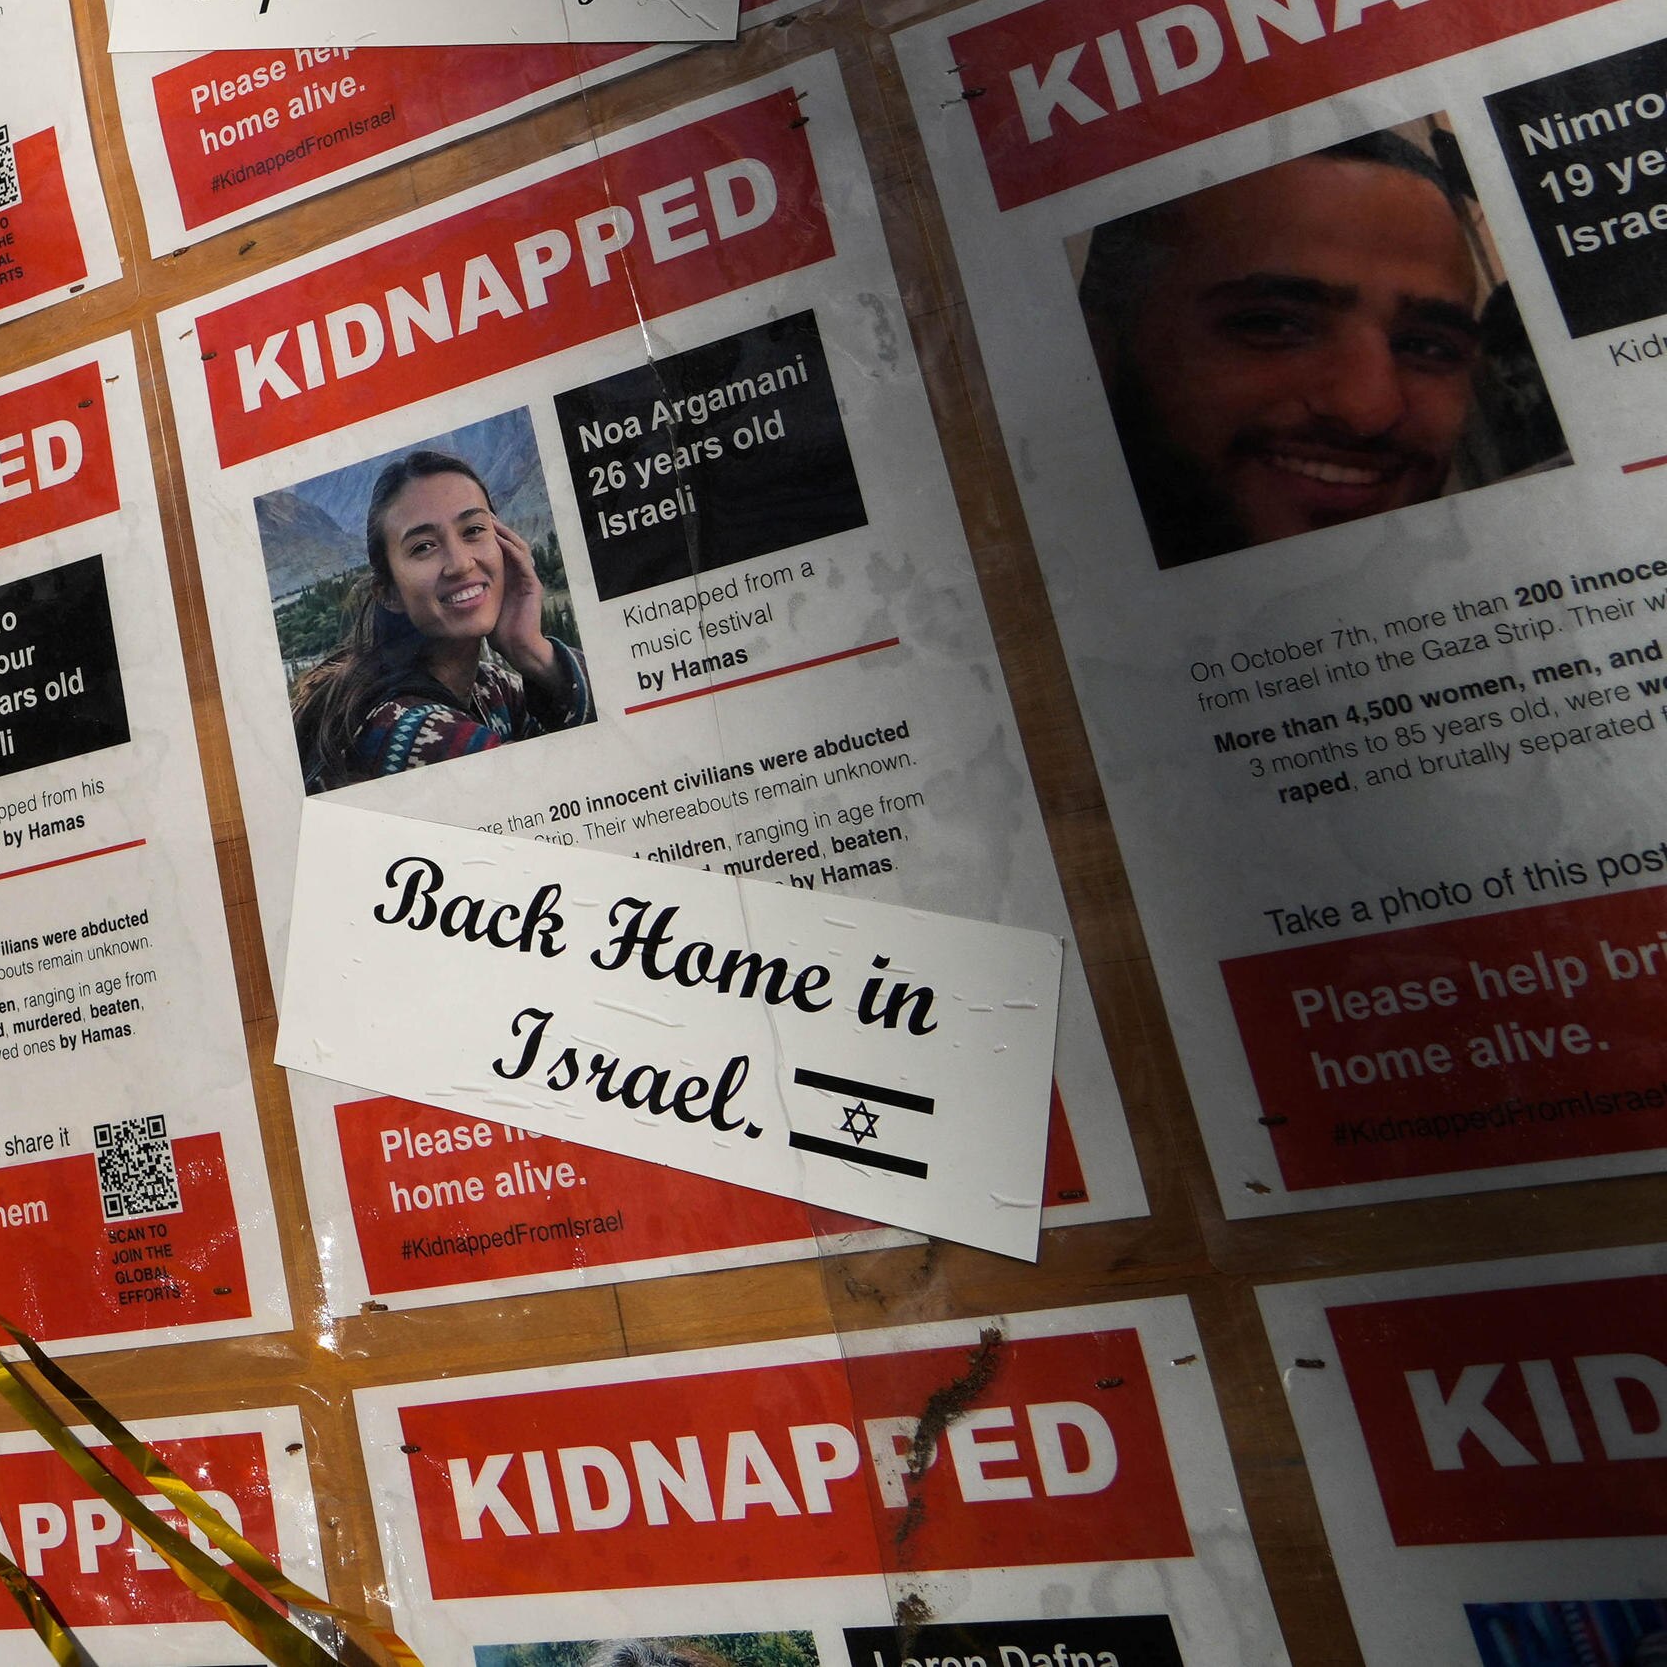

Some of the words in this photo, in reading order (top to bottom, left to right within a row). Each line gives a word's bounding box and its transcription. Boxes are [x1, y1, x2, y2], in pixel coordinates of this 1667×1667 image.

[234, 157, 778, 414] KIDNAPPED
[578, 416, 643, 454] Noa
[651, 354, 808, 436] Argamani
[588, 460, 627, 497] 26
[633, 436, 724, 490] years
[733, 409, 786, 450] old
[597, 484, 697, 540] Israeli
[44, 666, 85, 702] old
[2, 829, 23, 849] by
[27, 814, 86, 841] Hamas
[41, 787, 78, 808] from
[81, 778, 105, 798] his
[373, 856, 567, 959] Back
[589, 896, 833, 1013] Home
[857, 954, 938, 1036] in
[491, 1007, 764, 1139] Israel.
[447, 1401, 1118, 1540] KIDNAPPED
